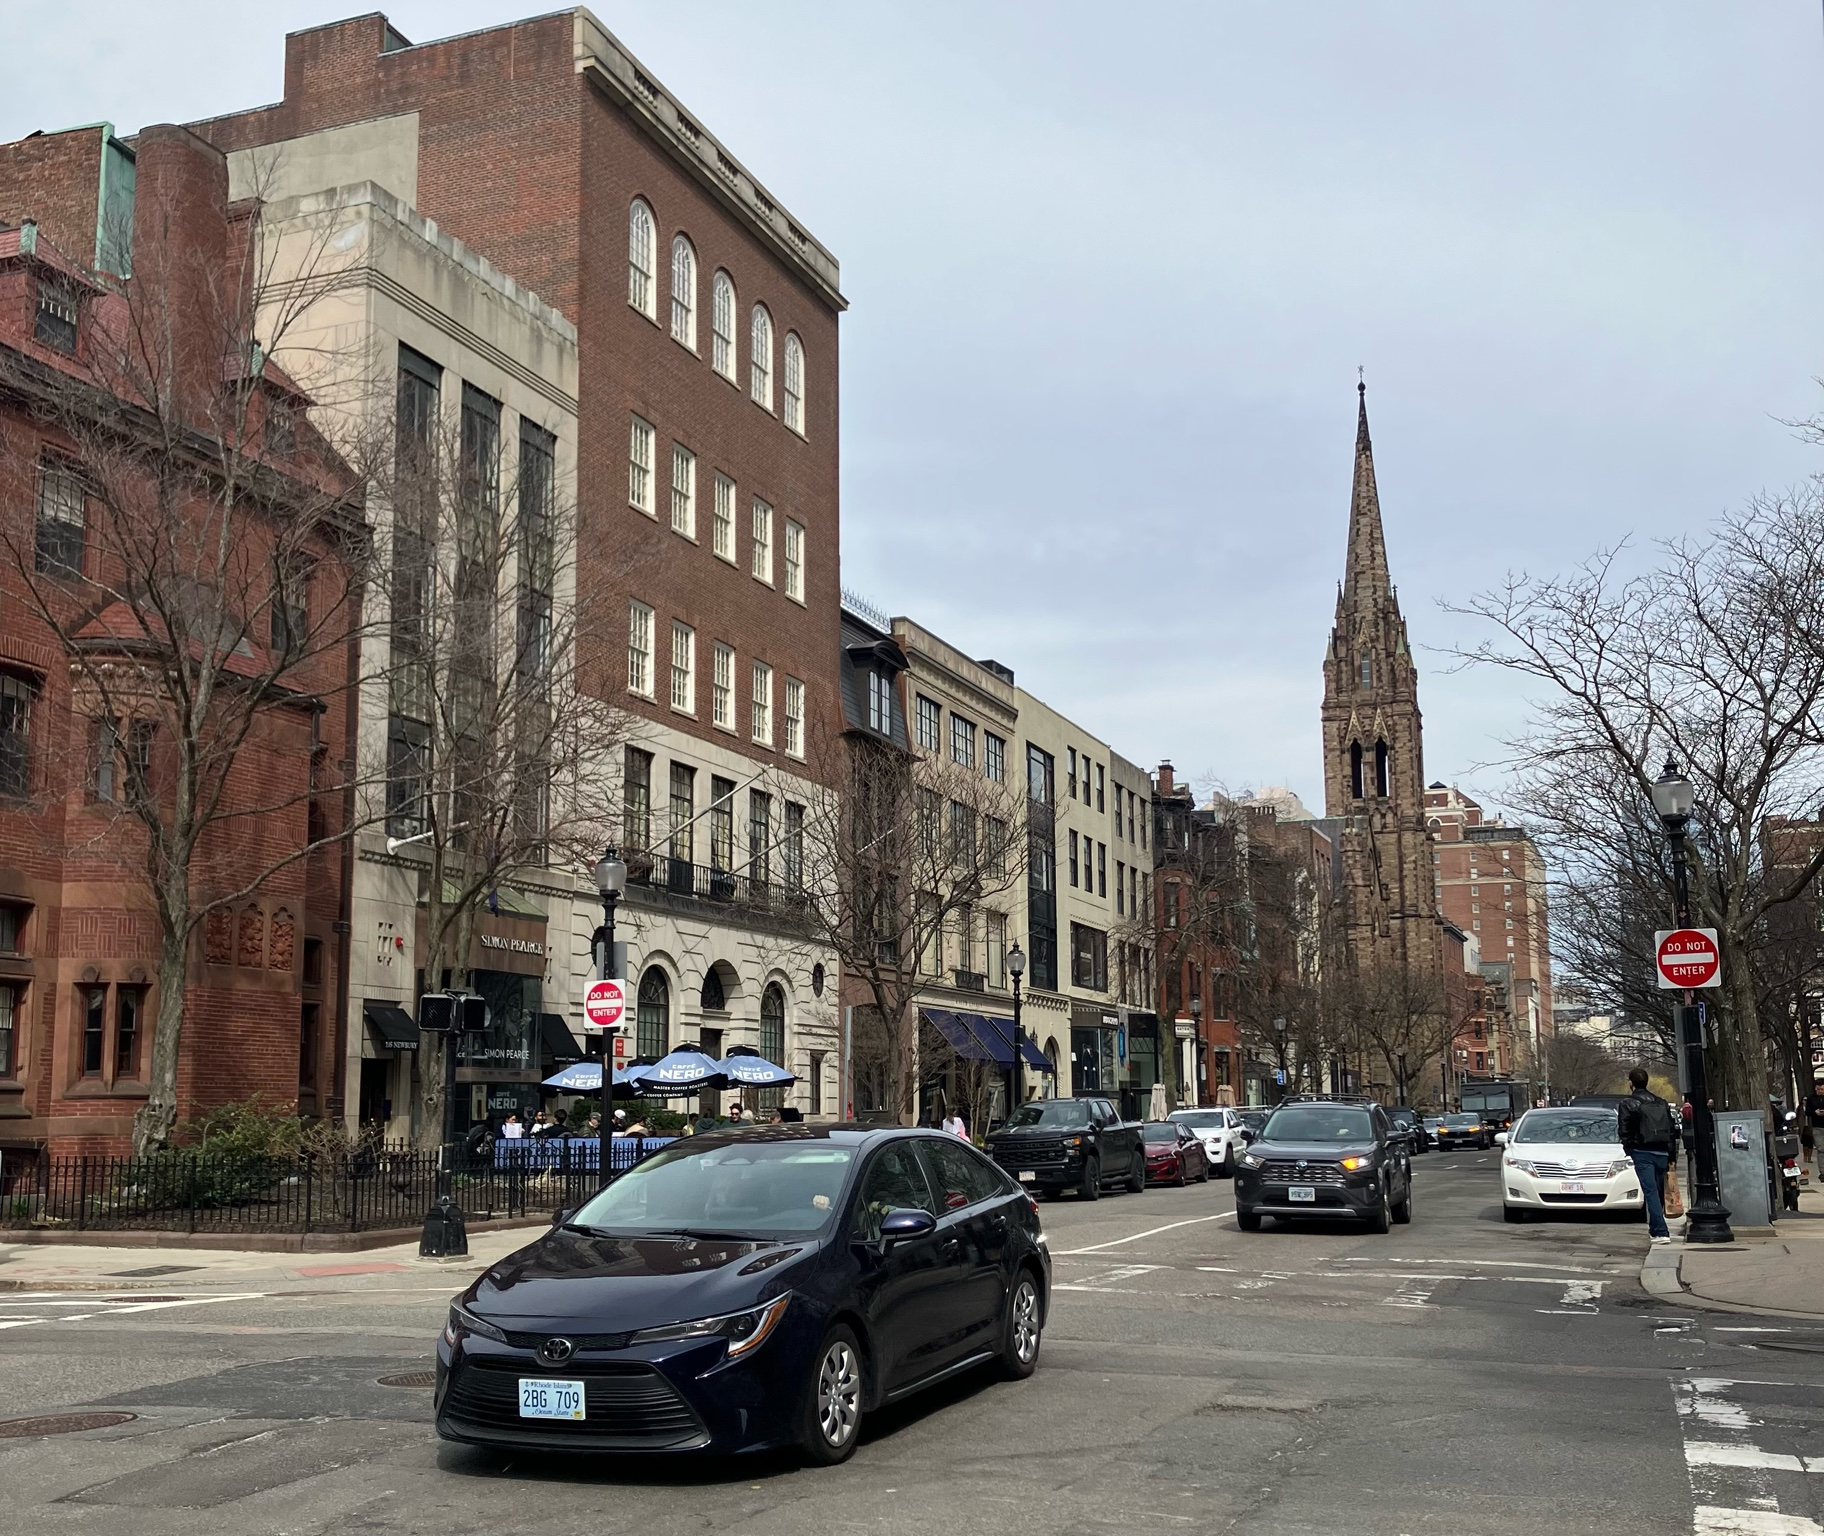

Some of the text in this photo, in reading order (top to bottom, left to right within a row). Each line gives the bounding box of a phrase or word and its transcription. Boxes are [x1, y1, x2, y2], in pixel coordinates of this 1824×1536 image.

[481, 935, 543, 955] SIMON PEARCE
[1667, 941, 1706, 952] DO NOT
[1672, 965, 1706, 976] ENTER
[590, 990, 619, 1000] DO NOT
[592, 1008, 617, 1017] ENTER
[393, 1041, 418, 1049] NEWBURY
[484, 1048, 529, 1060] SIMON PEARCE
[659, 1066, 705, 1080] NERO
[731, 1068, 774, 1081] NERO
[487, 1098, 518, 1110] NERO
[533, 1381, 552, 1389] Rhode
[523, 1389, 580, 1410] 2BG 709
